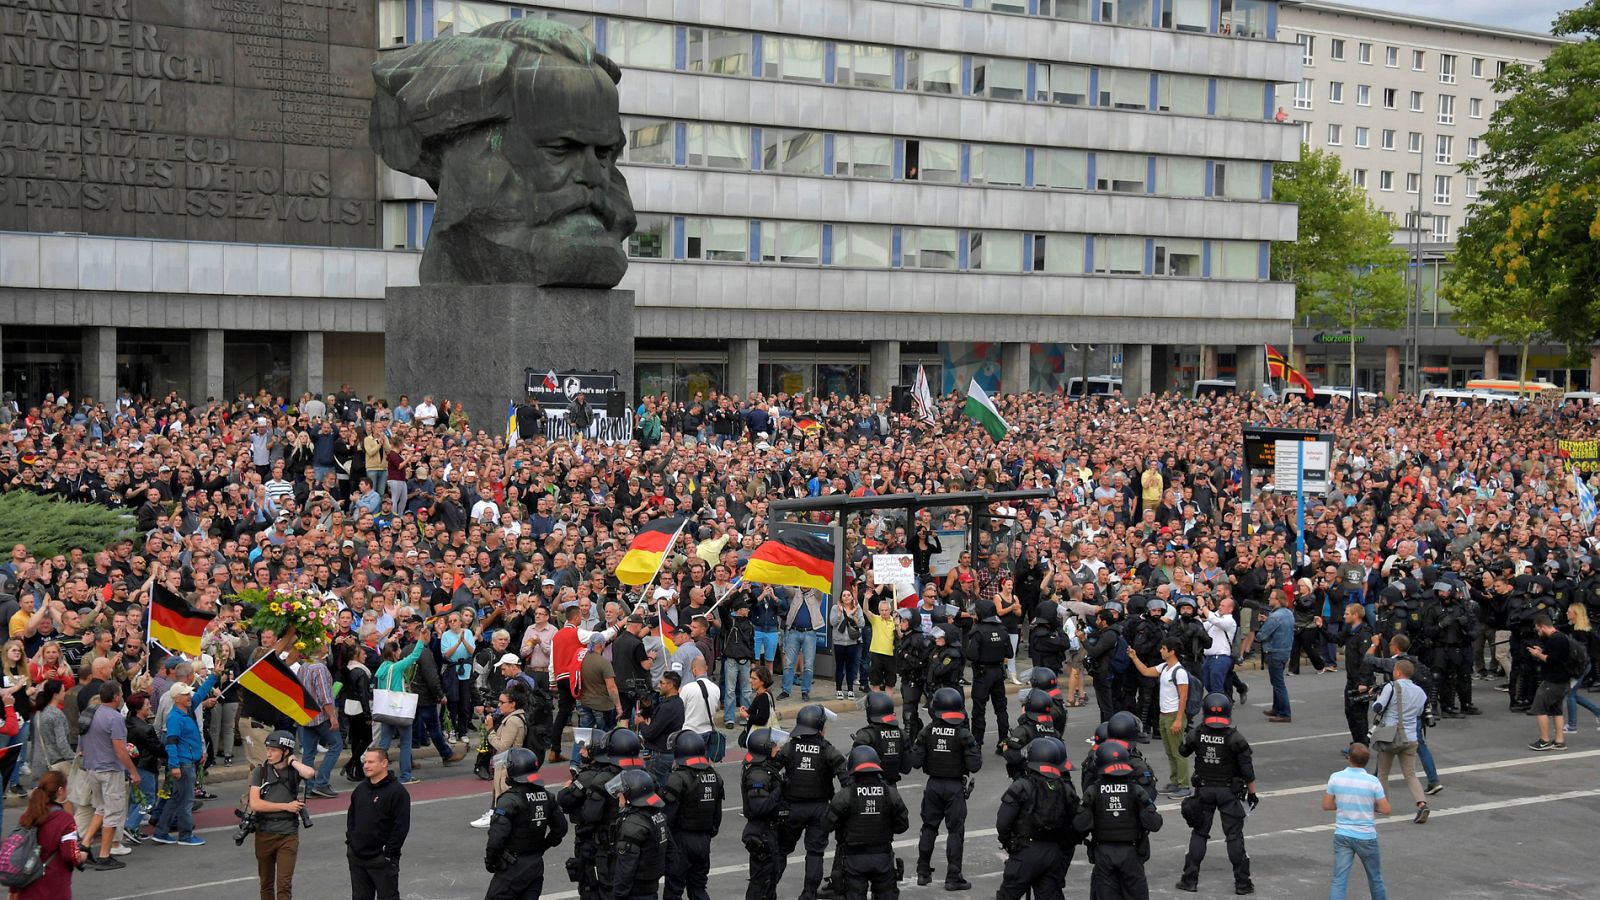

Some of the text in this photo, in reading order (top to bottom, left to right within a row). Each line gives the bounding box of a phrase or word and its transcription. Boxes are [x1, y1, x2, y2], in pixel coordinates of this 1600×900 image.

[112, 48, 223, 84] EUCH!
[880, 730, 900, 739] POLIZEI
[931, 727, 955, 736] POLIZEI
[1200, 734, 1224, 744] POLIZEI
[795, 743, 820, 754] POLIZEI
[857, 786, 884, 796] POLIZEI
[1100, 784, 1128, 794] POLIZEI
[526, 791, 548, 802] POLIZEI
[866, 799, 876, 807] SN
